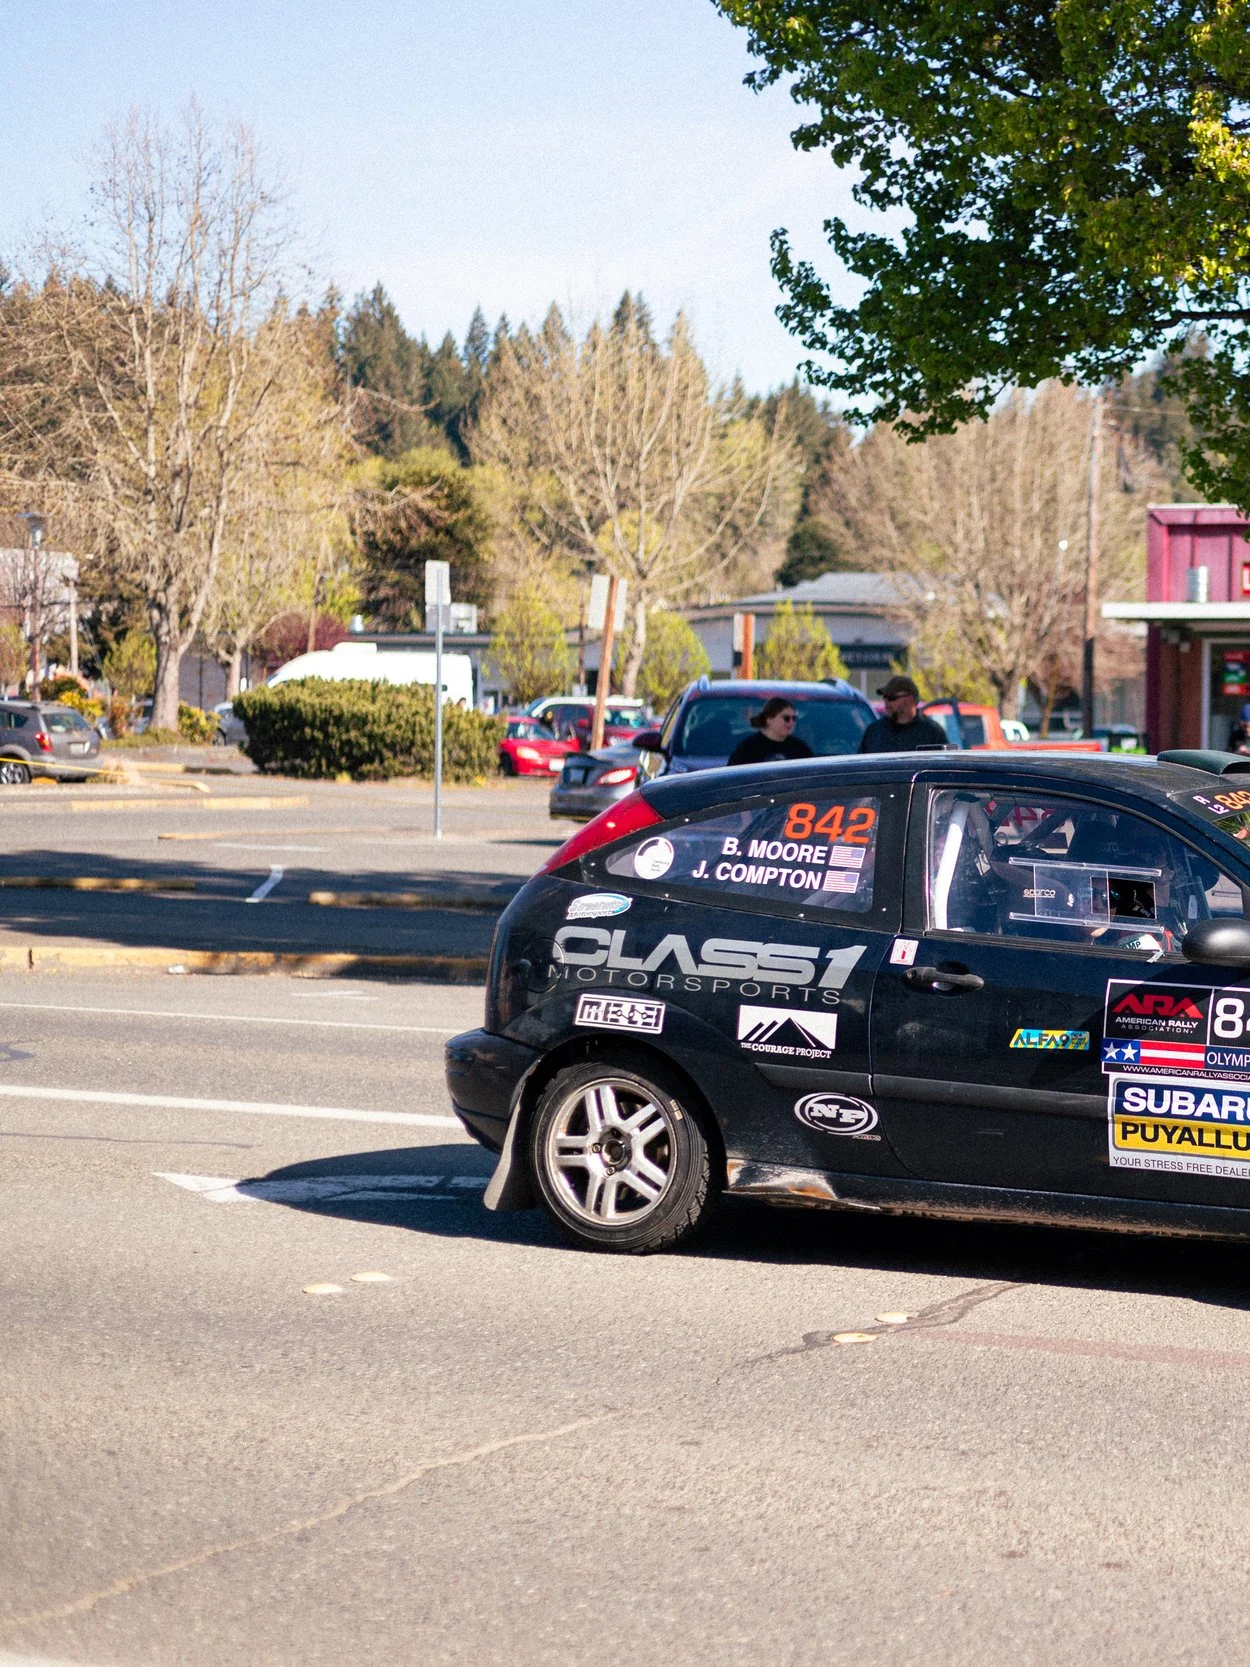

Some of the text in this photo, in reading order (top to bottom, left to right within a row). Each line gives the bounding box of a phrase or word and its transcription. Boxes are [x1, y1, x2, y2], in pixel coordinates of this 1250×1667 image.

[784, 803, 876, 844] 842
[722, 837, 828, 864] B. MOORE
[692, 860, 822, 890] J. COMPTON
[1023, 888, 1056, 899] sparco
[548, 967, 841, 1005] MOTORSPORTS
[1111, 992, 1204, 1019] ARA
[1115, 1016, 1198, 1029] AMERICAN RALLY
[751, 1043, 795, 1055] COURAGE
[795, 1047, 832, 1059] PROJECT
[1113, 1156, 1141, 1167] YOUR
[1143, 1159, 1184, 1171] STRESS
[1186, 1162, 1213, 1174] FREE
